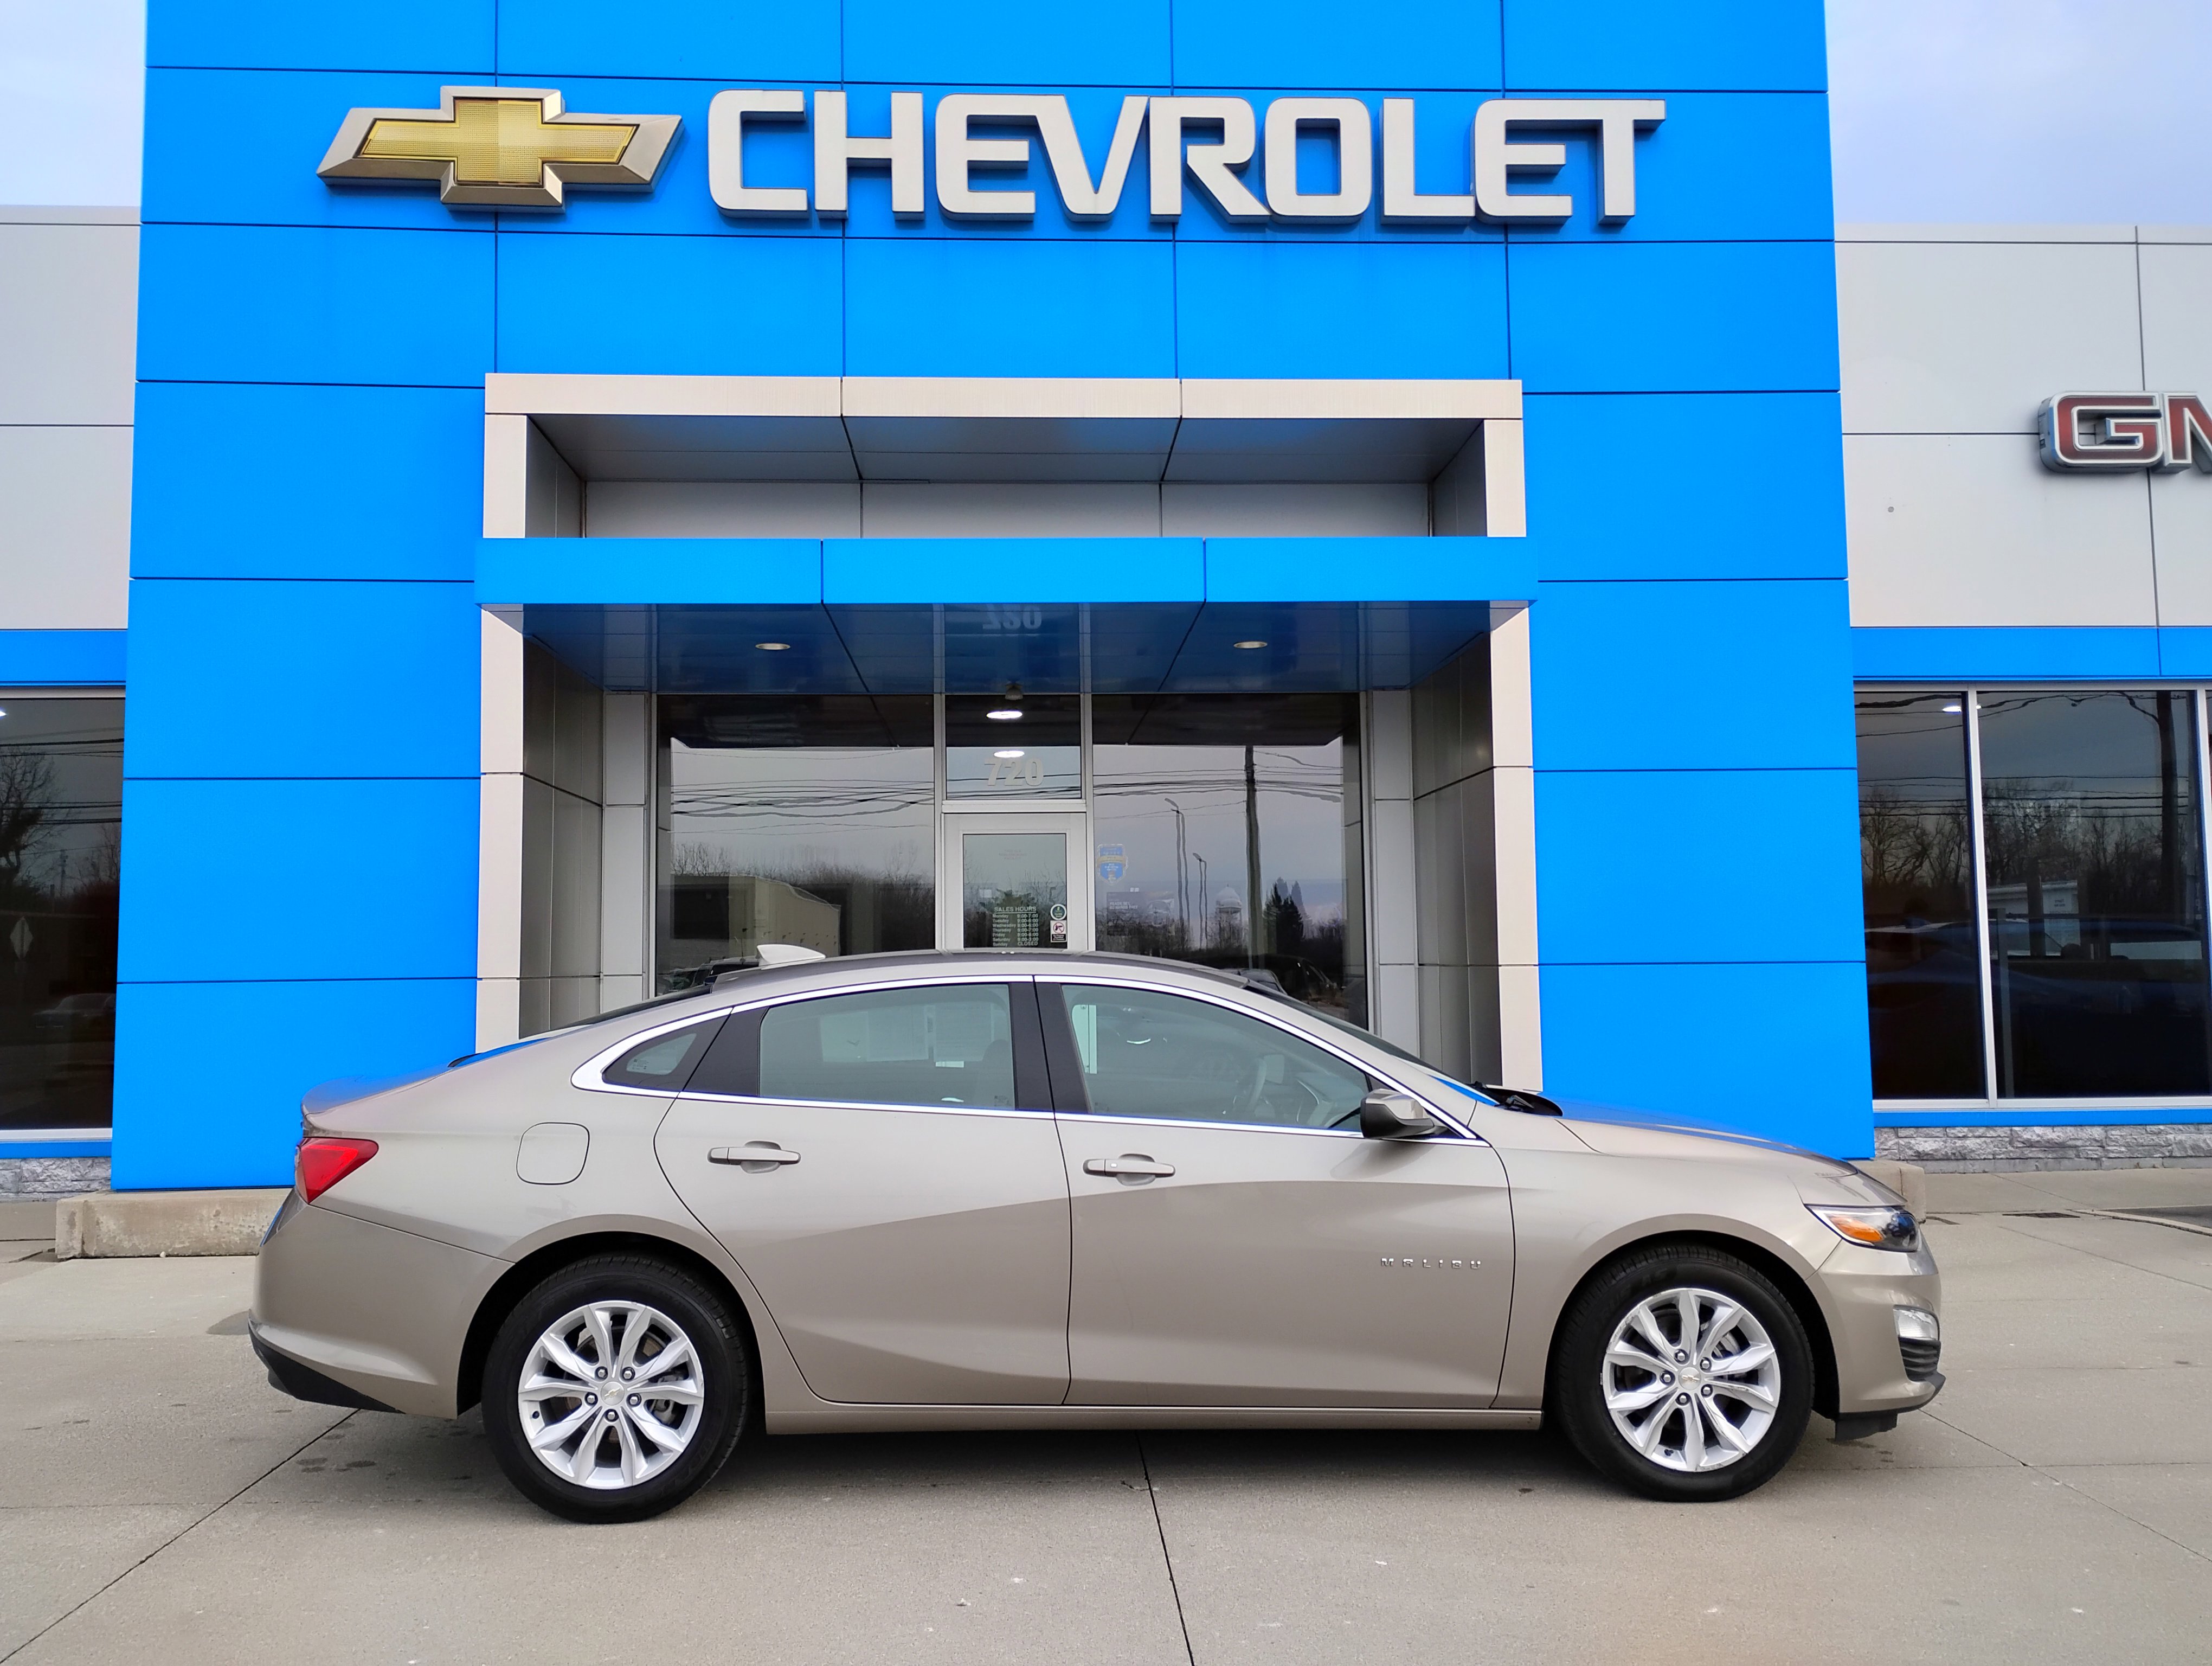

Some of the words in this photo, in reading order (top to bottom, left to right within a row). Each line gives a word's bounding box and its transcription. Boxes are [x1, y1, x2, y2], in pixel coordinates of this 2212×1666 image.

[708, 90, 1666, 225] CHEVROLET
[984, 759, 1044, 786] 720
[1381, 1258, 1481, 1270] MALIBU
